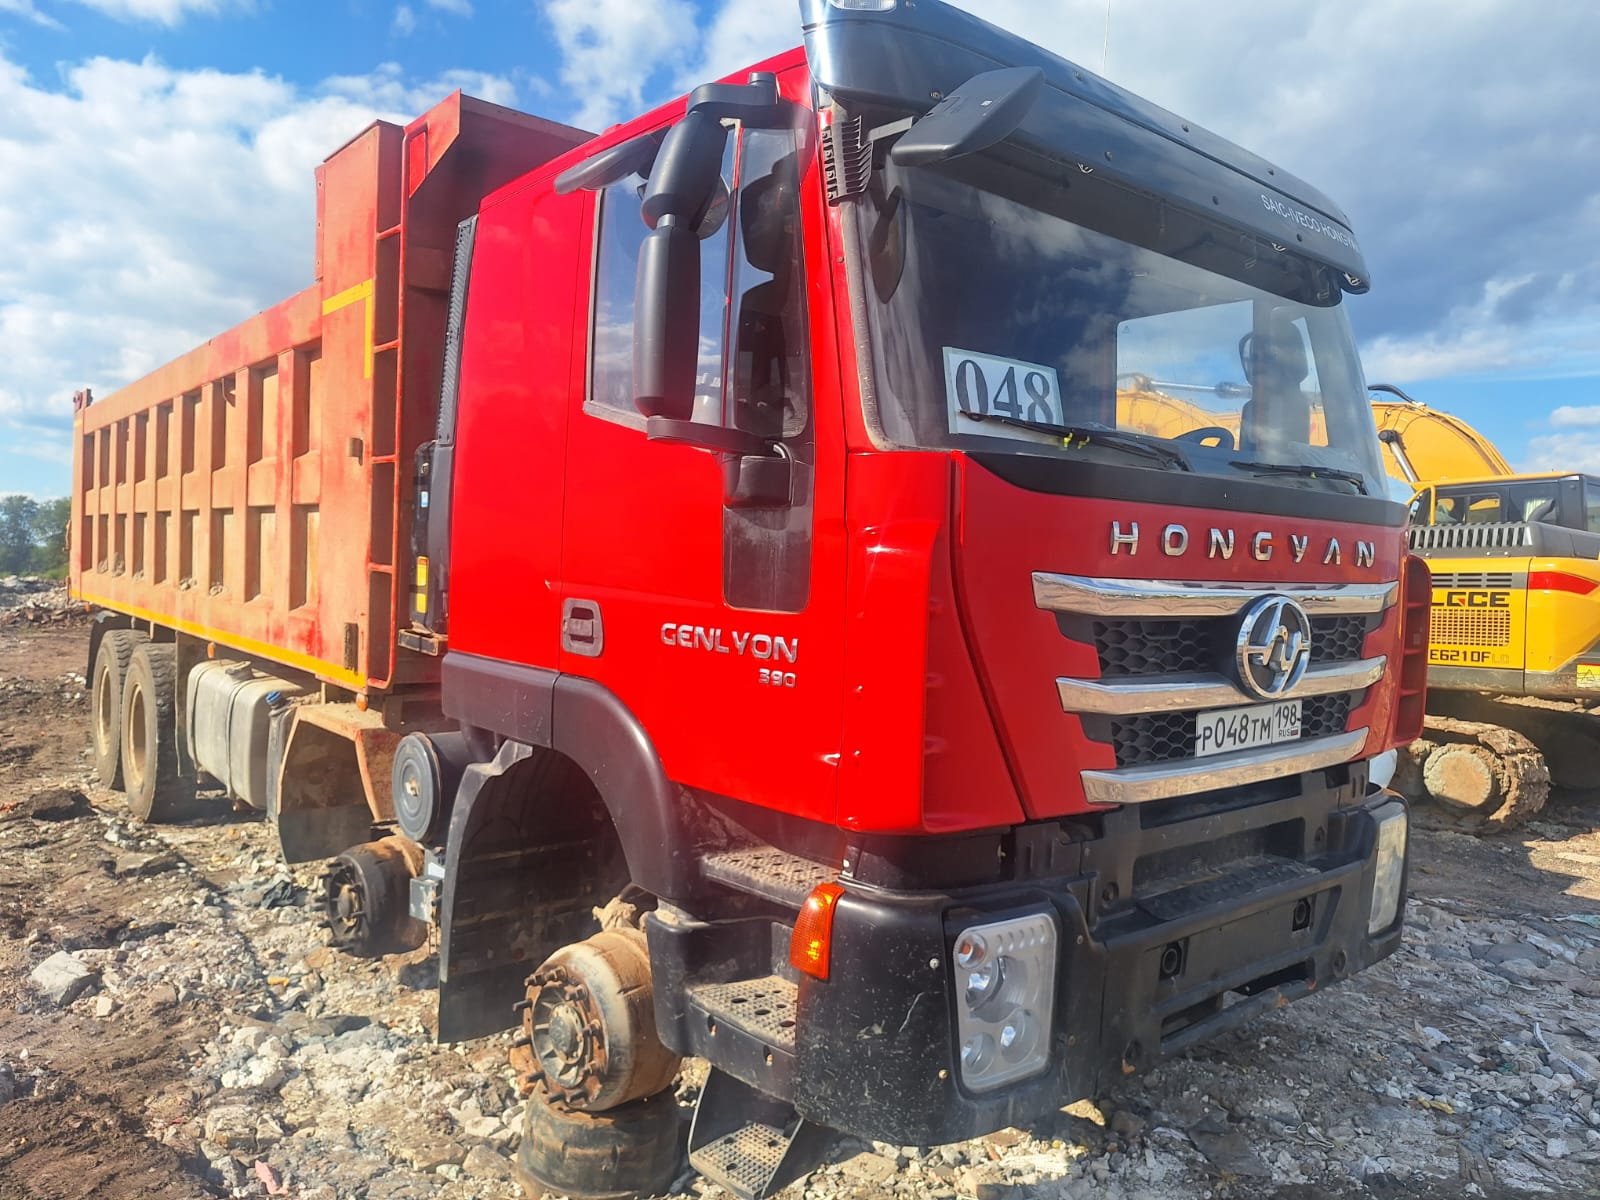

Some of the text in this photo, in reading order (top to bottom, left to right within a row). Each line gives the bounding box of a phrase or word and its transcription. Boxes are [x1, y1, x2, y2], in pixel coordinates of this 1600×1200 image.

[956, 359, 1054, 423] 048
[1110, 520, 1375, 568] HONGYAN
[661, 622, 799, 663] GENLYON
[758, 668, 797, 688] 390
[1275, 703, 1297, 729] 198
[1279, 729, 1291, 737] RUS
